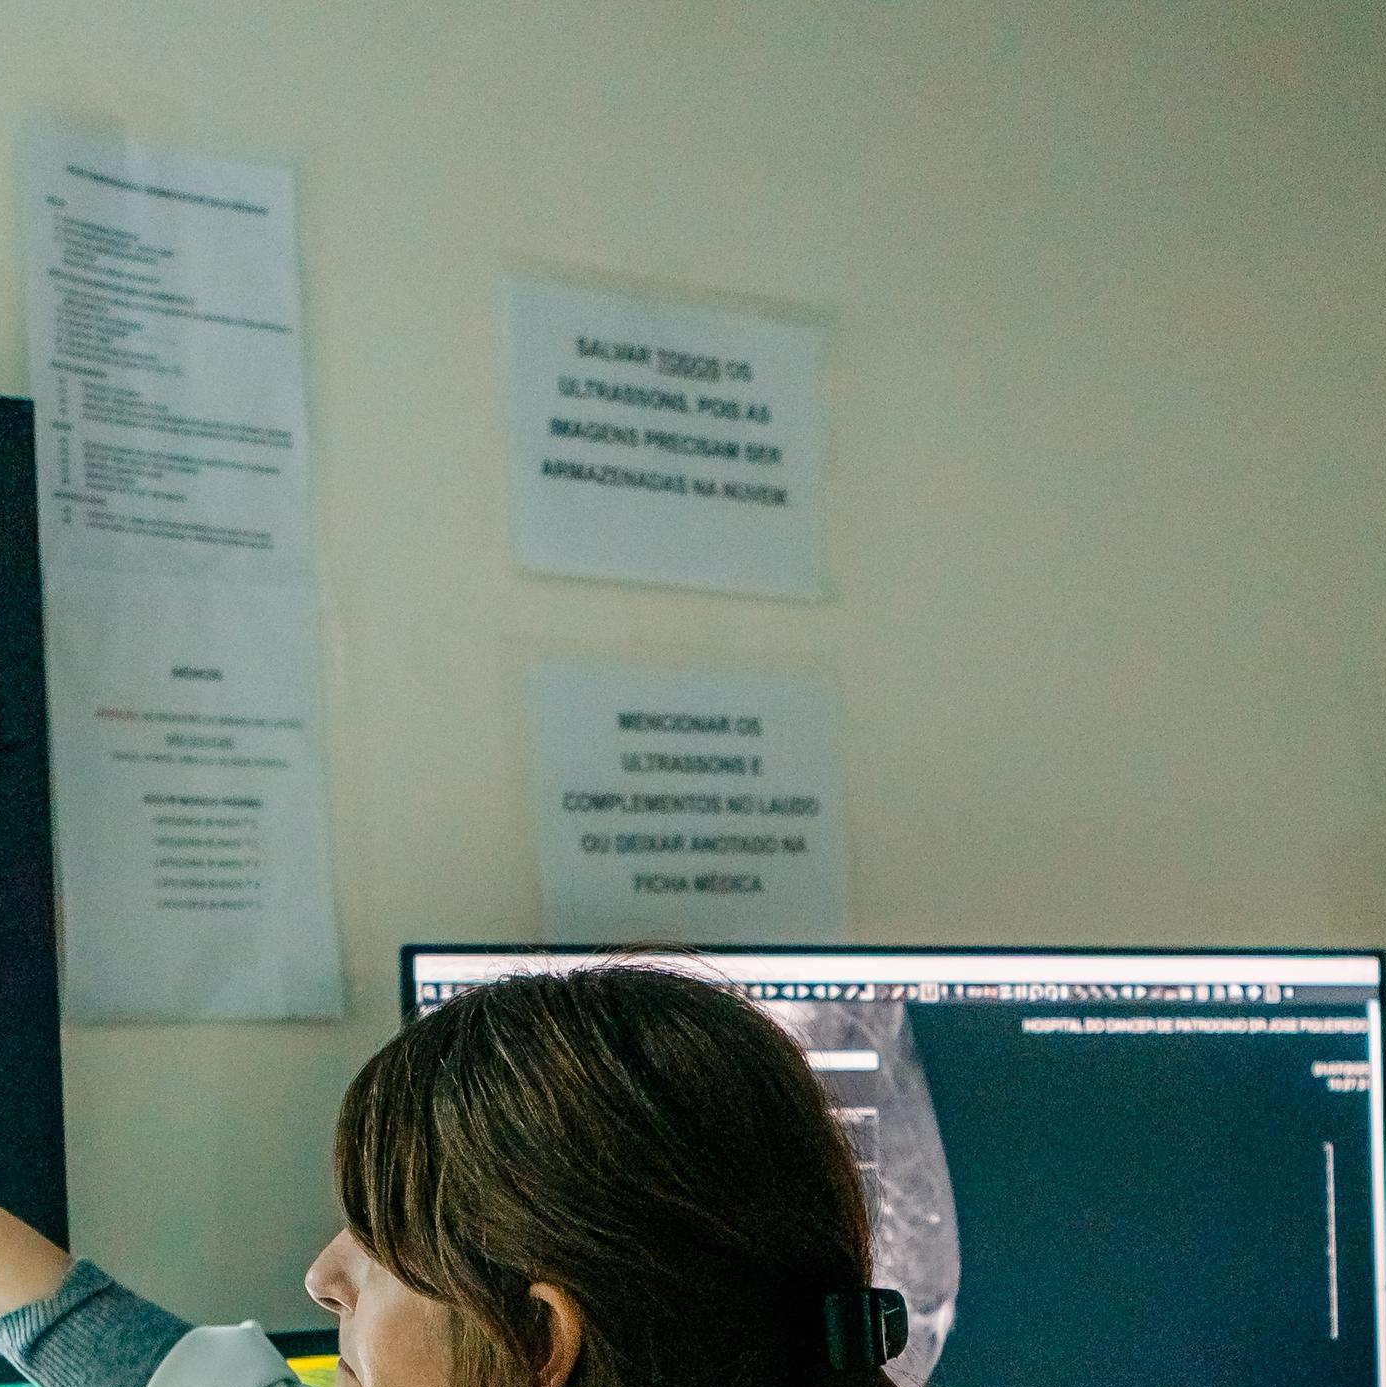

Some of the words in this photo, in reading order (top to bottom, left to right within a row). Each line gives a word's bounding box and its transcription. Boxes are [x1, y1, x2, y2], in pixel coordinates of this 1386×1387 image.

[576, 337, 652, 364] SALVAR
[656, 348, 722, 383] TODOS
[548, 417, 639, 448] IMAGENS
[643, 428, 740, 460] PRECISAM
[744, 442, 782, 464] SER
[541, 459, 688, 495] ARMAZENADAS
[617, 712, 731, 734] MENCIONAR
[562, 791, 722, 815] COMPLEMENTOS
